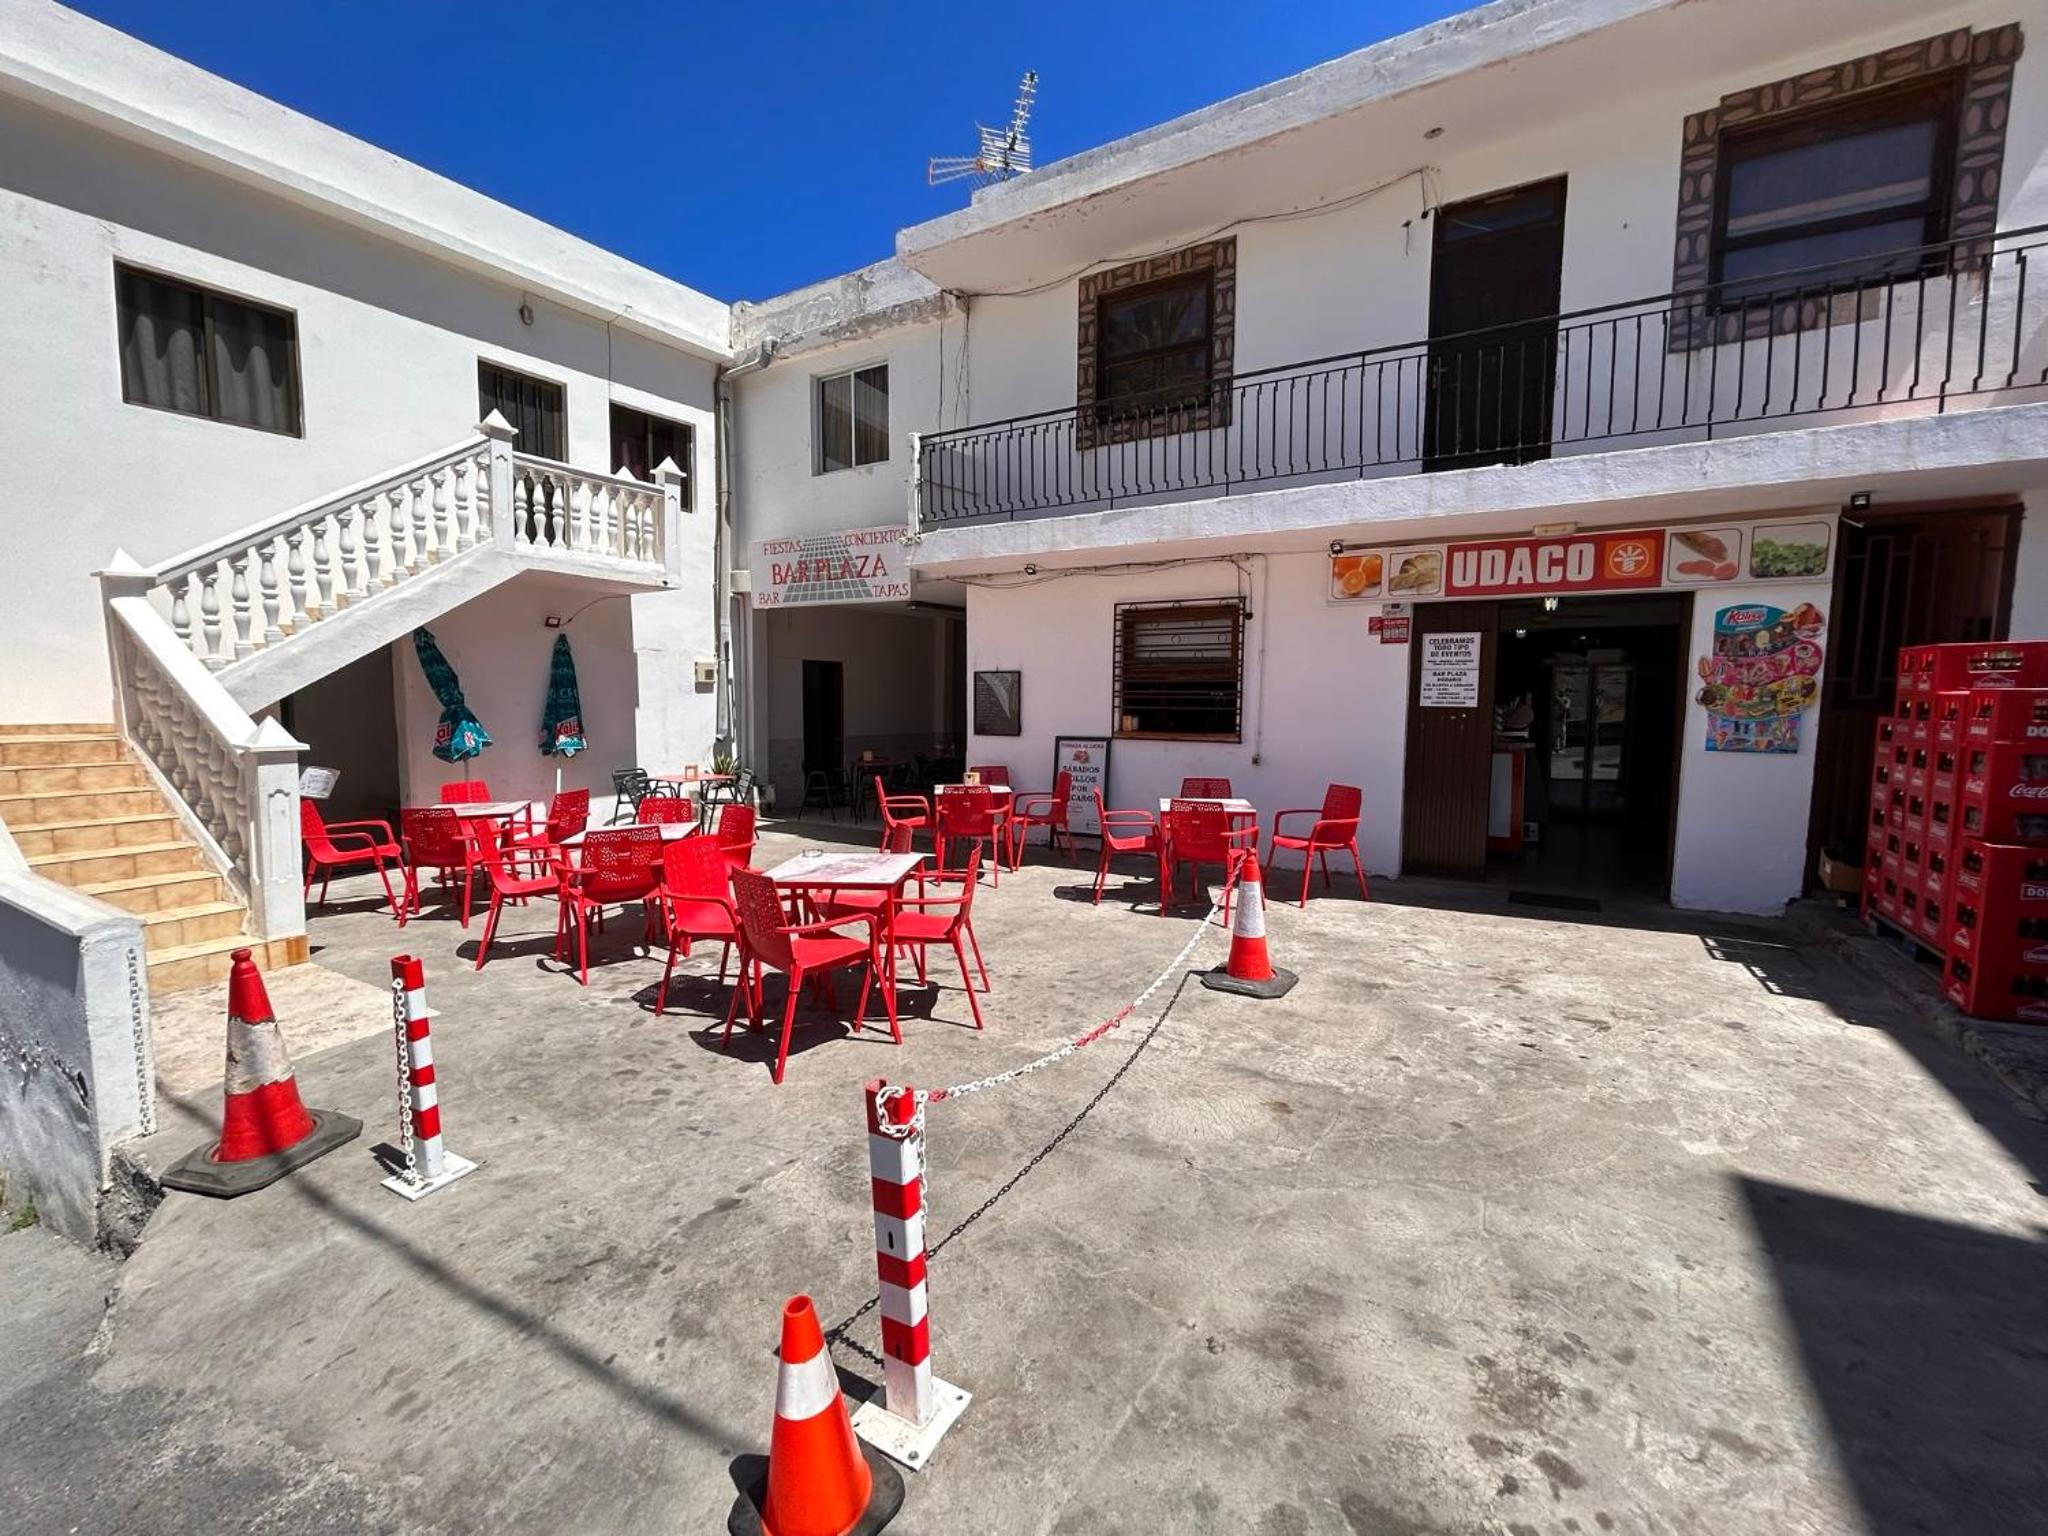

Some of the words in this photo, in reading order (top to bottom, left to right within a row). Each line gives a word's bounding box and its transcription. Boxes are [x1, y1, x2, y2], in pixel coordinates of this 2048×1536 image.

[843, 528, 908, 547] CONCIERTOS
[763, 541, 803, 556] FIESTAS
[772, 559, 809, 585] BAR
[815, 553, 889, 581] PLAZA
[1451, 542, 1595, 588] UDACO
[759, 592, 780, 605] BAR
[872, 583, 909, 598] TAPAS
